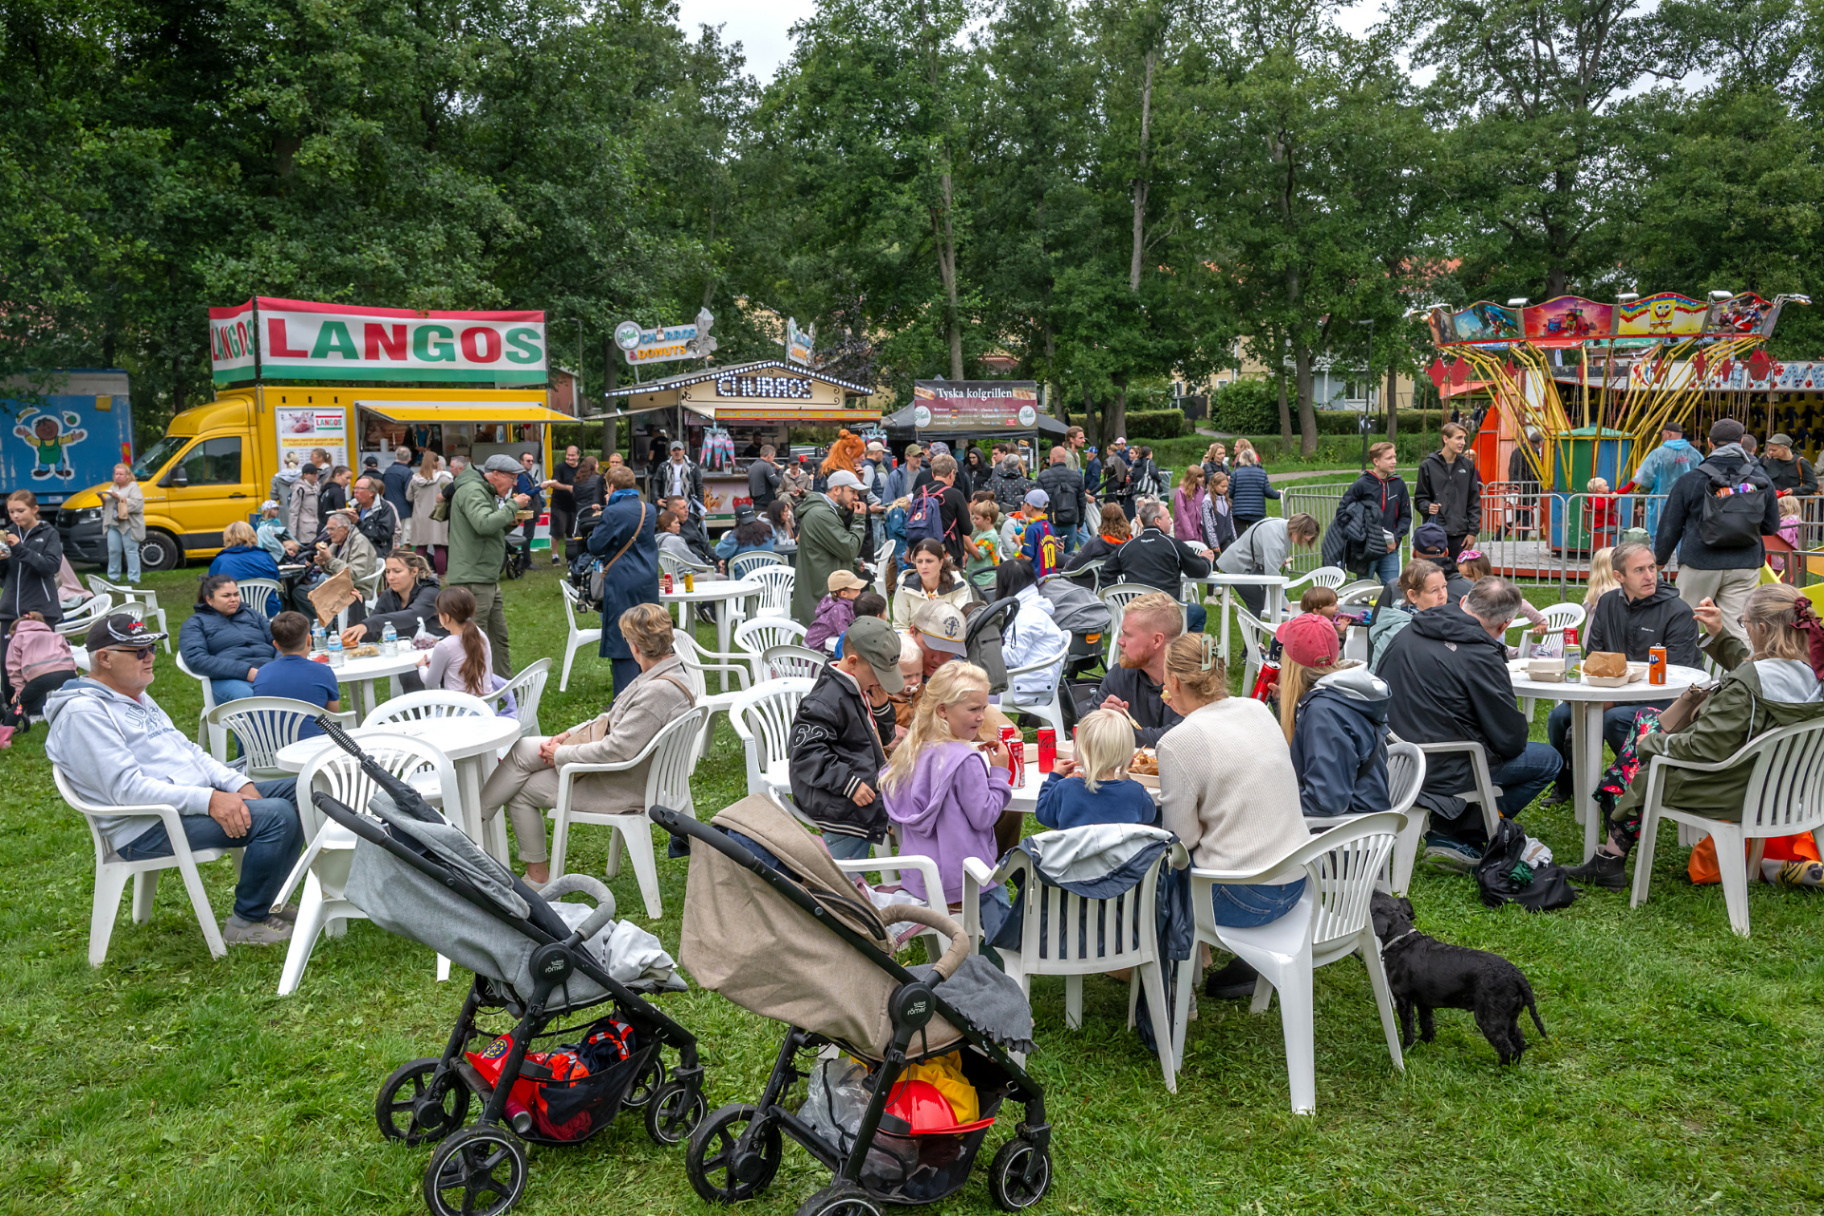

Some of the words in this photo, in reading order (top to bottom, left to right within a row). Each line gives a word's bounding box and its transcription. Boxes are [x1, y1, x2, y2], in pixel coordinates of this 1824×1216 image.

[210, 318, 254, 362] LANGOS
[267, 317, 543, 365] LANGOS
[640, 328, 697, 344] CHRROS
[638, 345, 687, 360] DONUTS
[717, 376, 813, 399] CHURROS
[936, 387, 964, 401] Tyska
[966, 387, 1013, 402] kolgrillen
[316, 418, 342, 427] LANGOS
[1043, 542, 1056, 569] 10
